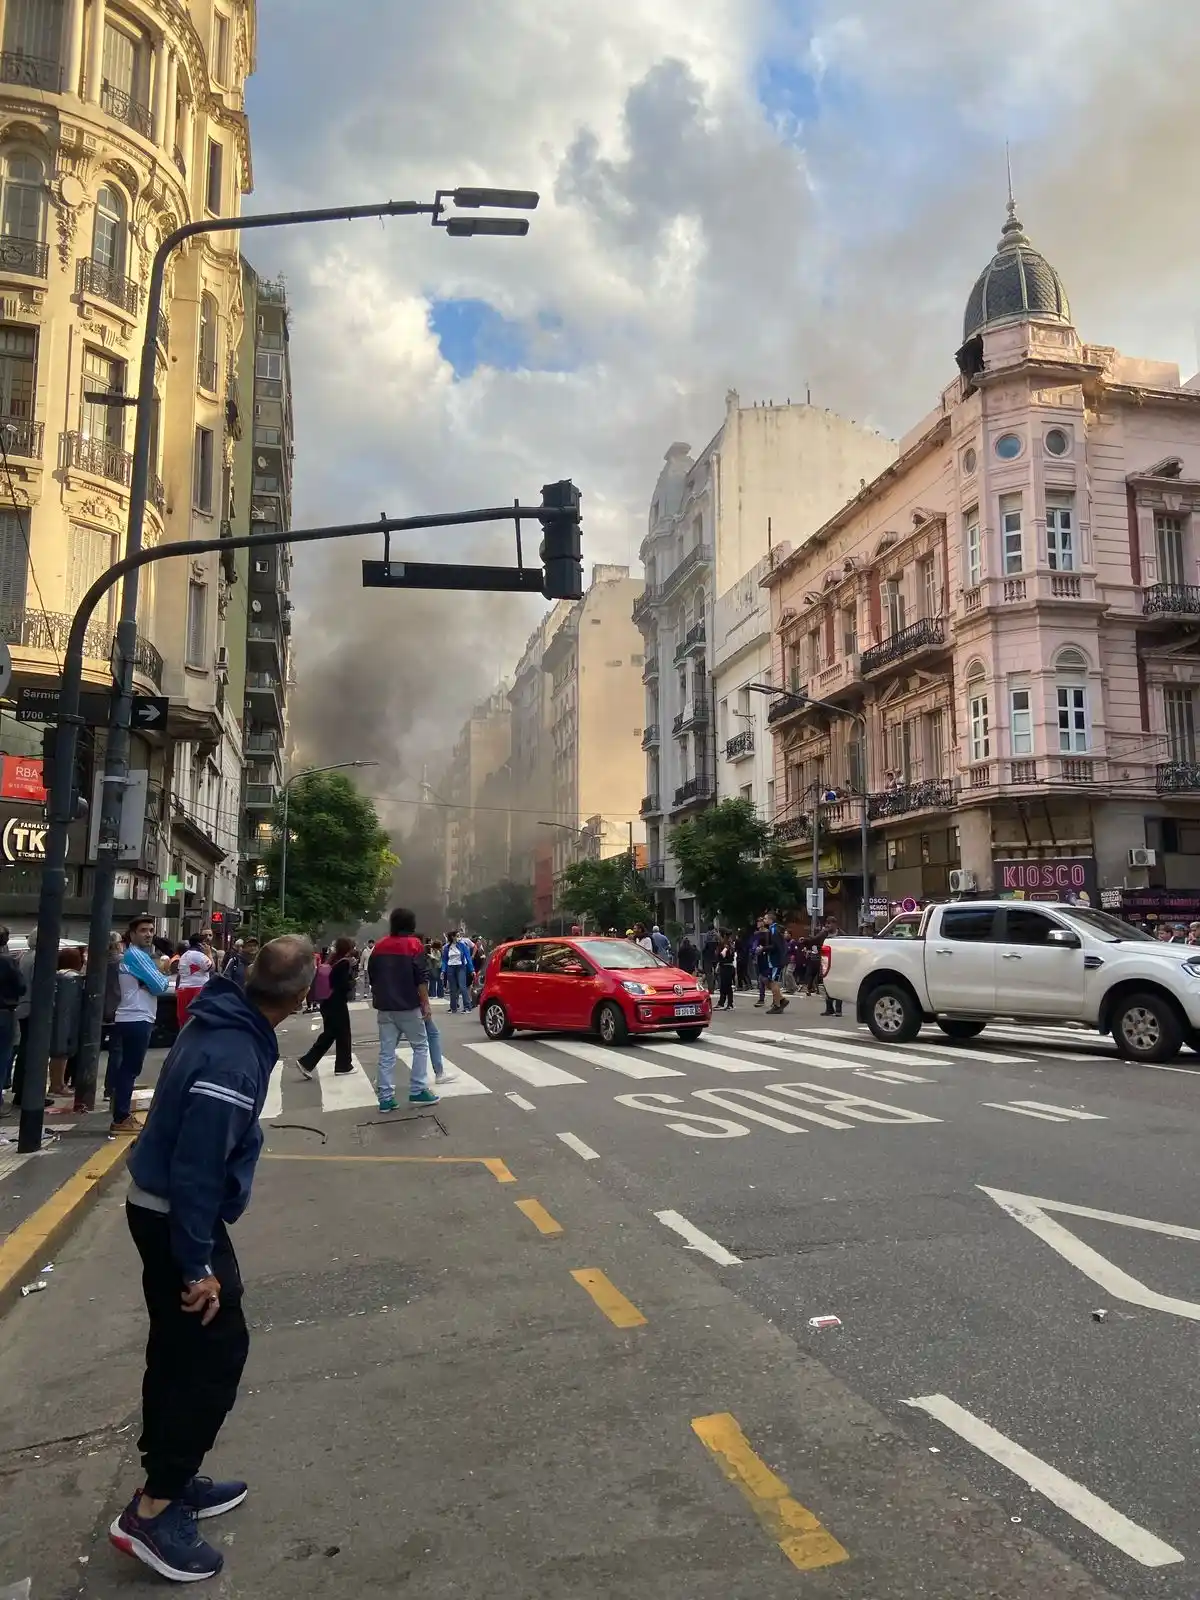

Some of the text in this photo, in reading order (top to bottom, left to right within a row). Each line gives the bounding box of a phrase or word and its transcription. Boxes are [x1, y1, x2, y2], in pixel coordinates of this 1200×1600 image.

[23, 689, 60, 700] Sarmie
[20, 710, 44, 720] 1700
[15, 766, 39, 780] RBA
[13, 828, 47, 852] TK
[1003, 864, 1085, 888] KIOSCO
[613, 1082, 945, 1139] BUS
